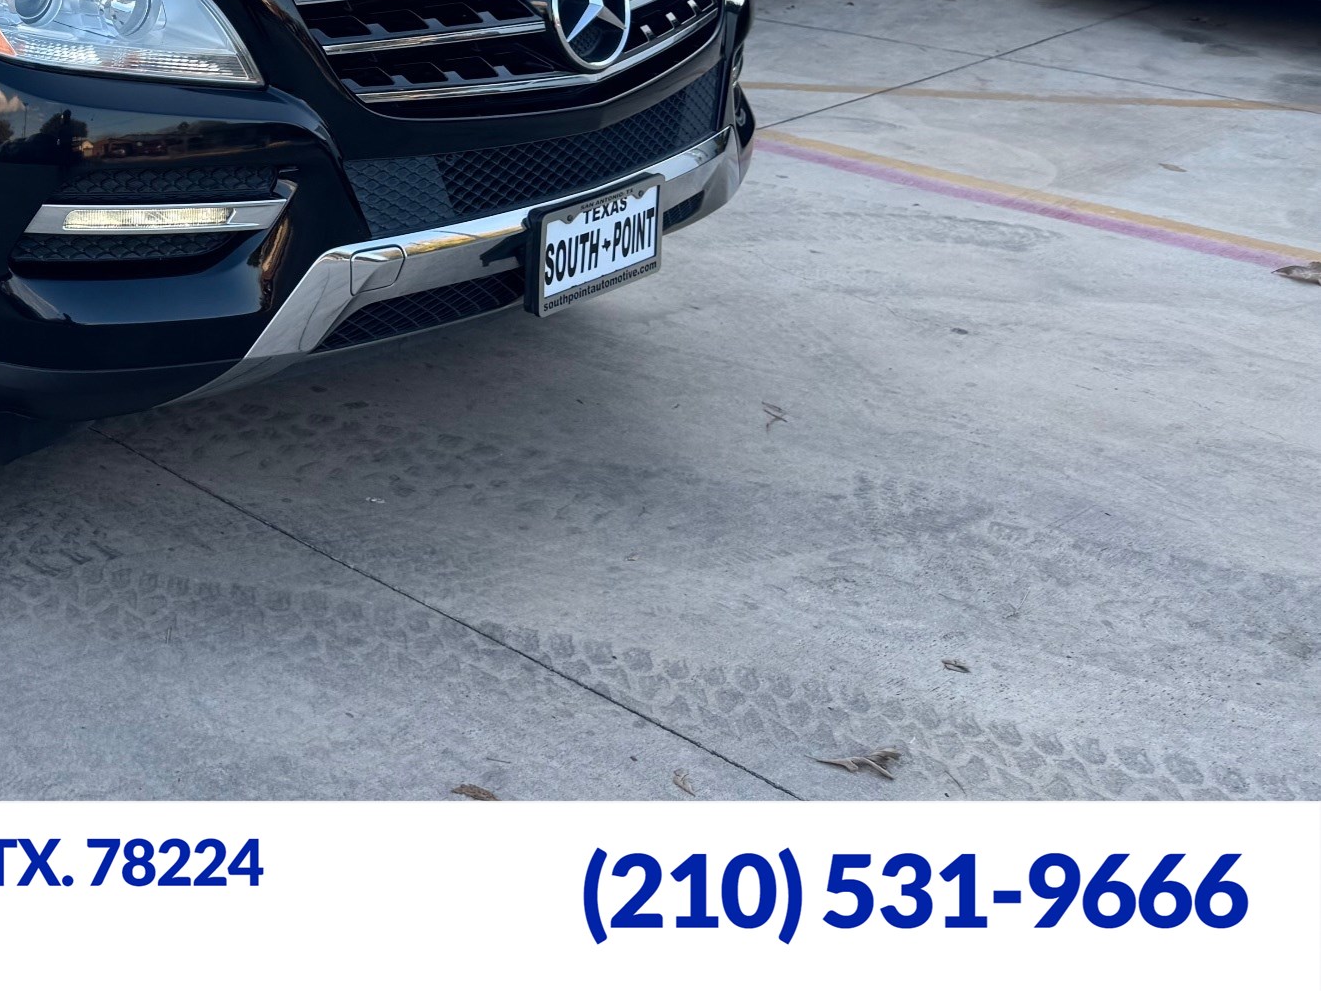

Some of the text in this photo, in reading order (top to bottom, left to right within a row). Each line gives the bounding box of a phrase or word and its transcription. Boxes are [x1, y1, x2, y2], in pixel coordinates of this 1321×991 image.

[583, 197, 628, 224] TEXAS
[545, 207, 655, 286] SOUTH POINT
[543, 260, 657, 311] southpointautomotive.com
